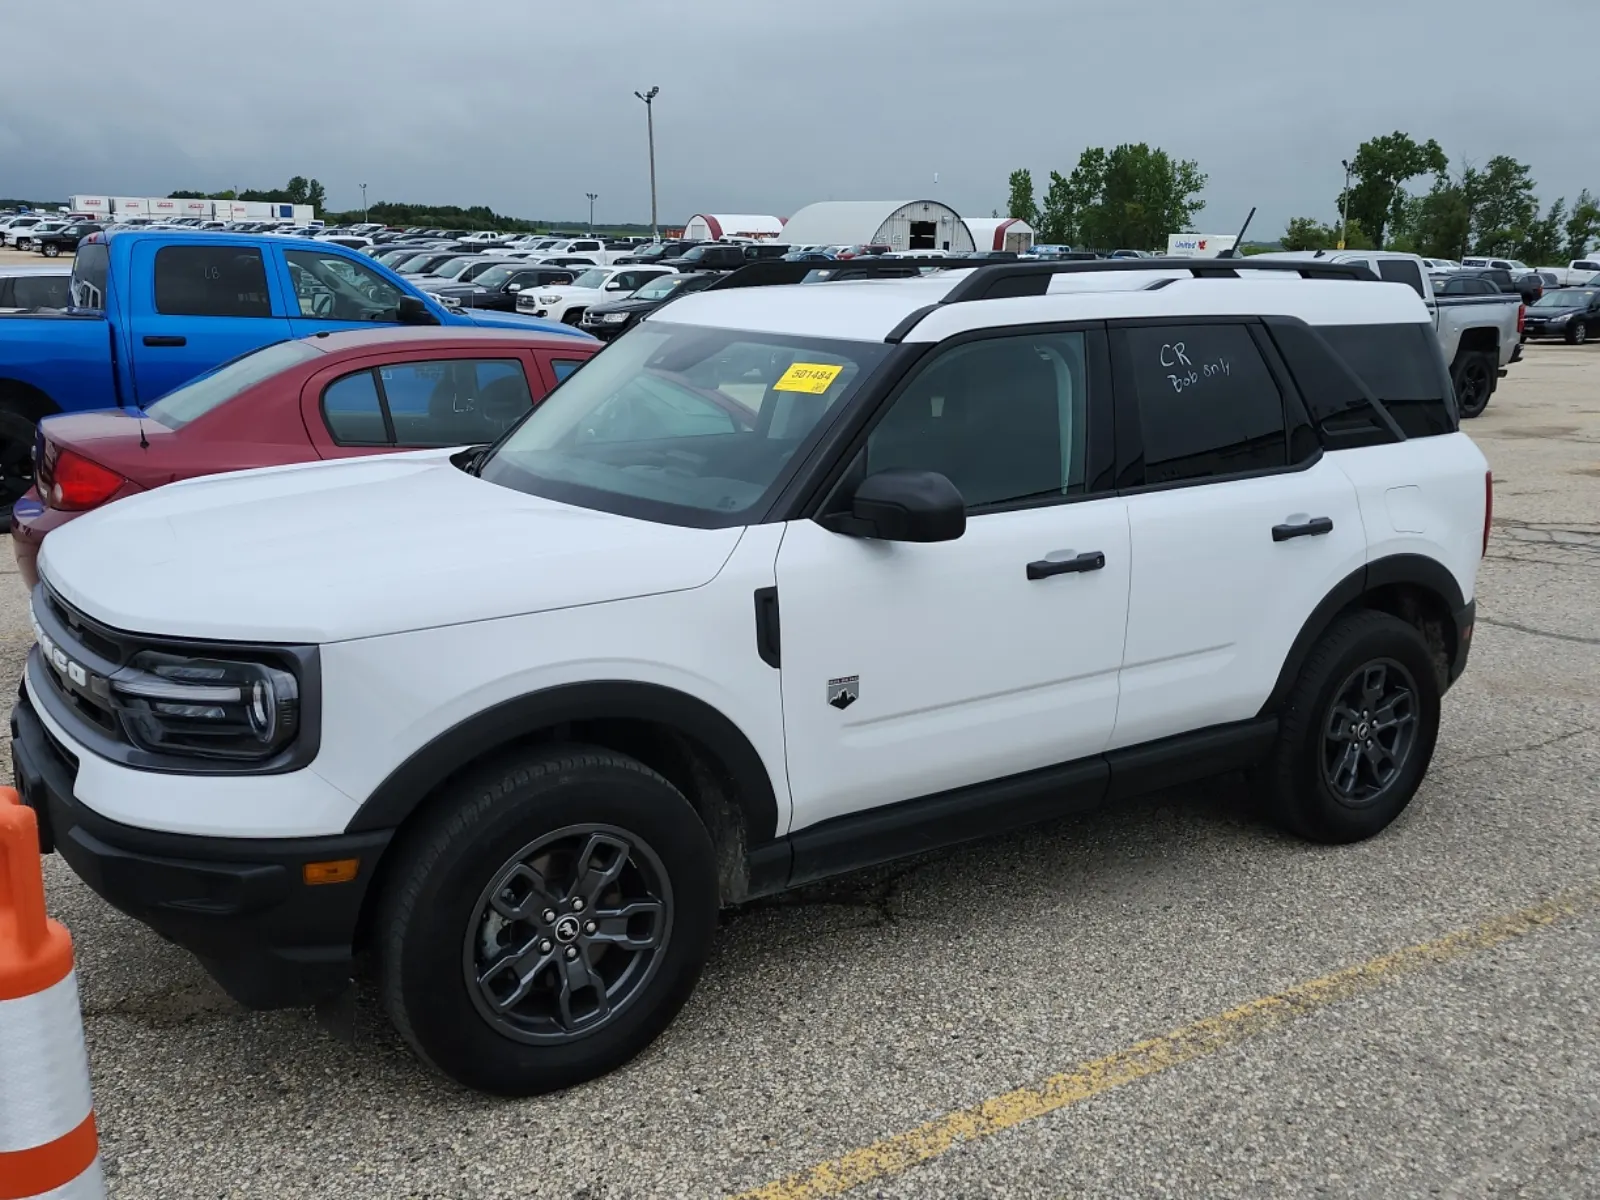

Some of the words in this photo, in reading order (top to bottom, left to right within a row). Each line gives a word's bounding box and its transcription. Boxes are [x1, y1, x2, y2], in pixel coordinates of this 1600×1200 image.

[1160, 342, 1192, 367] CR
[791, 369, 833, 380] 501484
[1167, 370, 1198, 393] Bob
